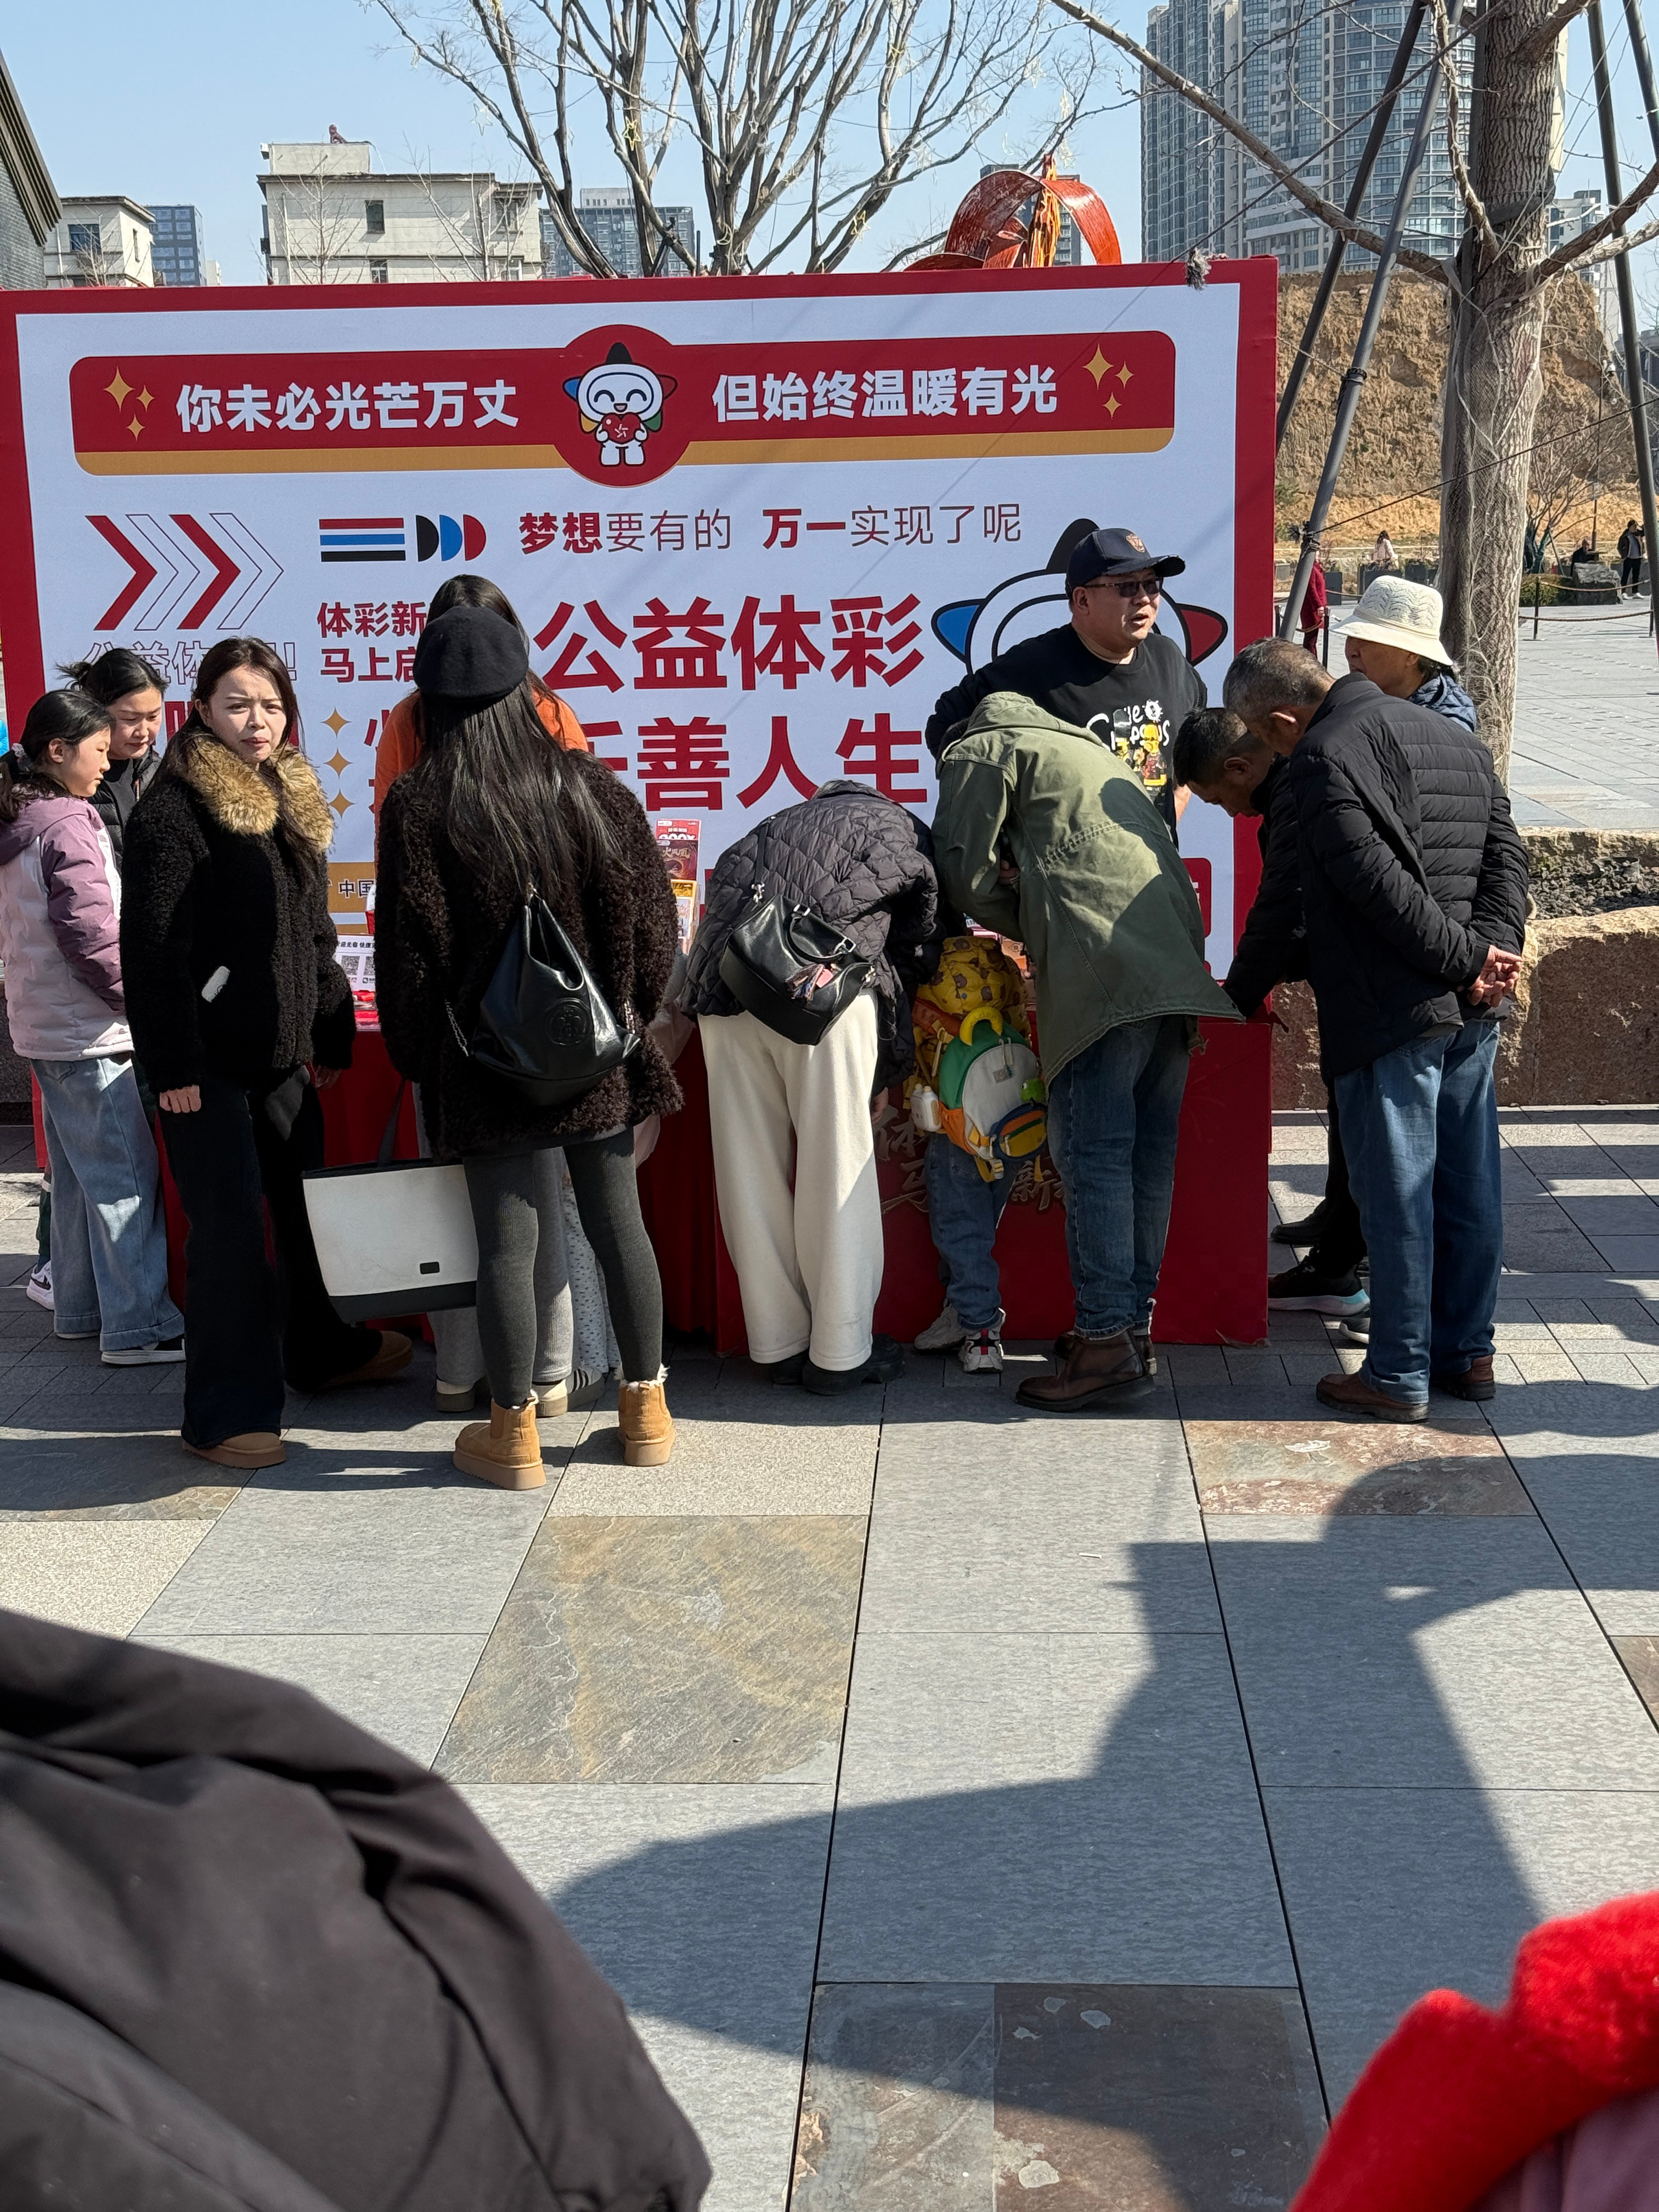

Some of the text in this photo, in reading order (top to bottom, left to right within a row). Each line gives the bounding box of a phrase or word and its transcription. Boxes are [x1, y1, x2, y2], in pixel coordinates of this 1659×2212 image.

[176, 379, 519, 433] 你未必光芒万丈
[712, 365, 1058, 422] 但始终温暖有光
[518, 503, 1022, 555] 梦想要有的 万一实现了呢
[534, 594, 924, 692] 公益体彩
